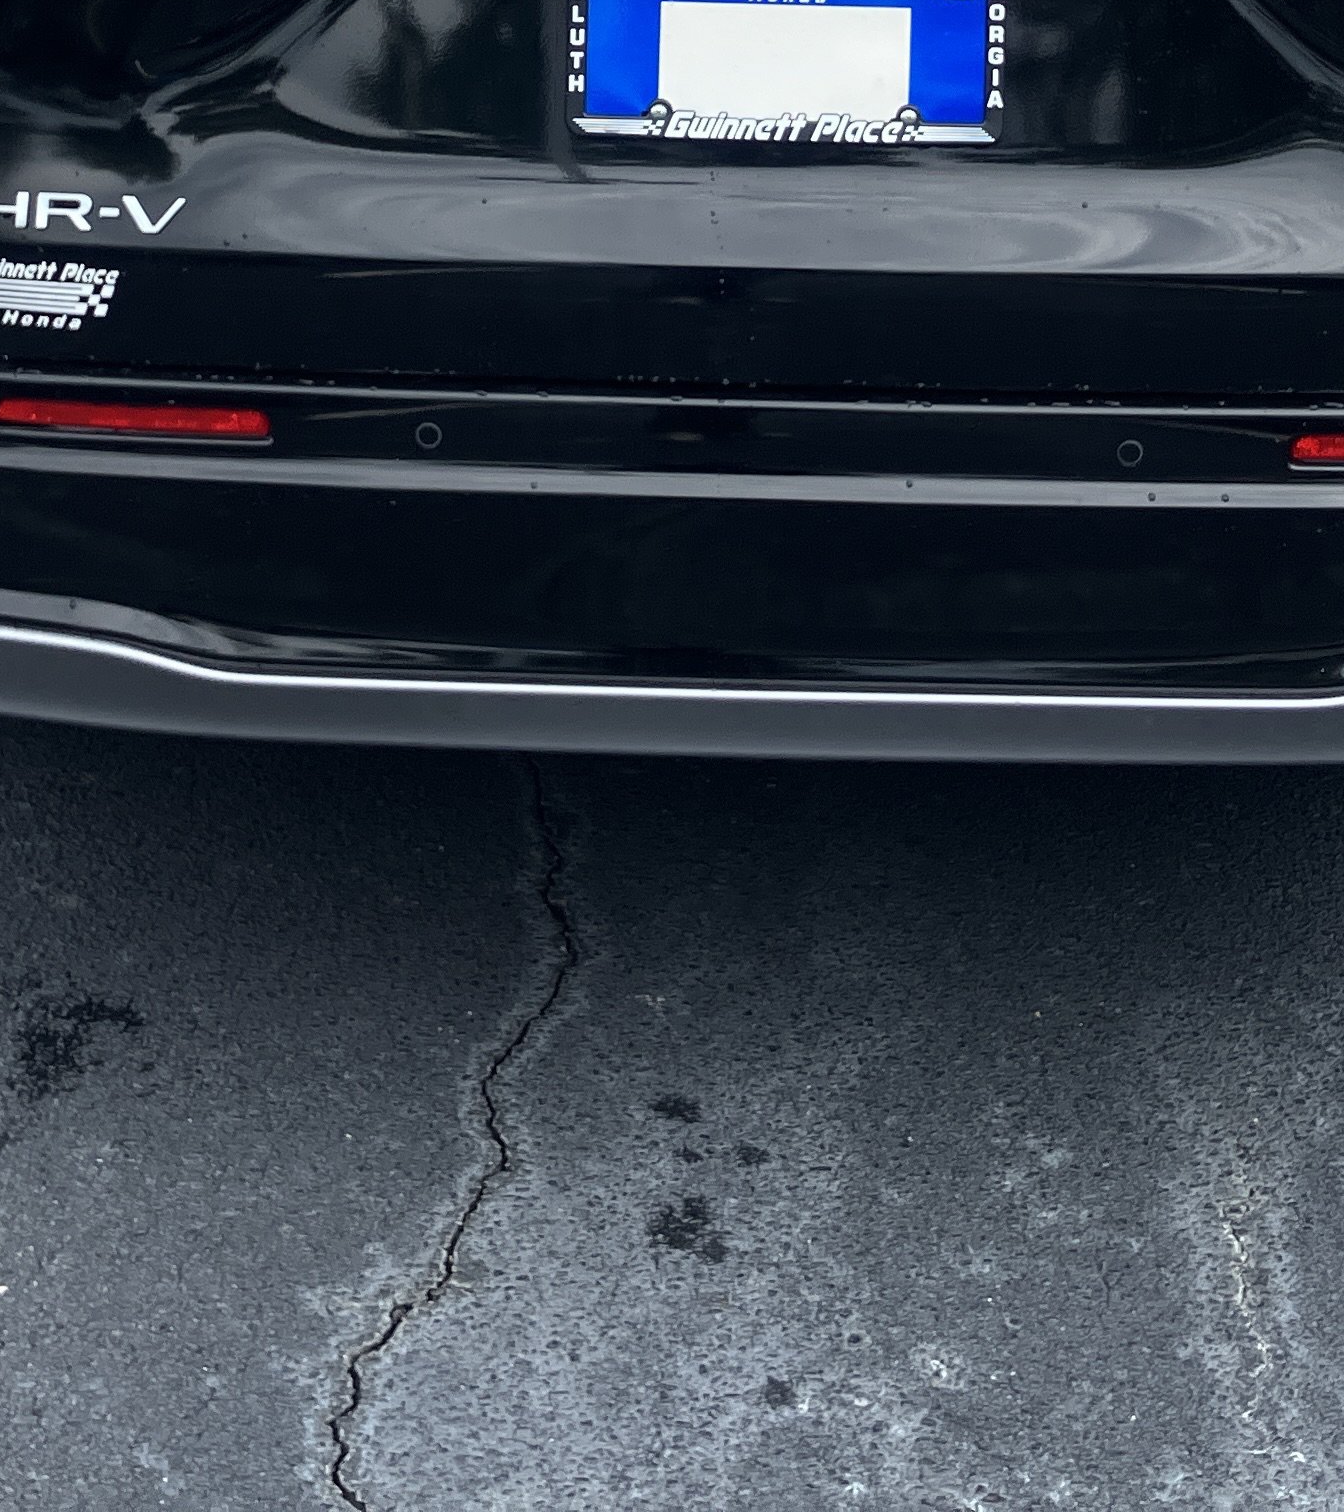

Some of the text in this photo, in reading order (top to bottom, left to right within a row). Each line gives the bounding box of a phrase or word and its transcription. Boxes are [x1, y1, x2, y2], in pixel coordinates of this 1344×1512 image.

[664, 109, 903, 144] Gwinnett Place
[60, 263, 120, 285] Place
[1, 308, 83, 332] Honda
